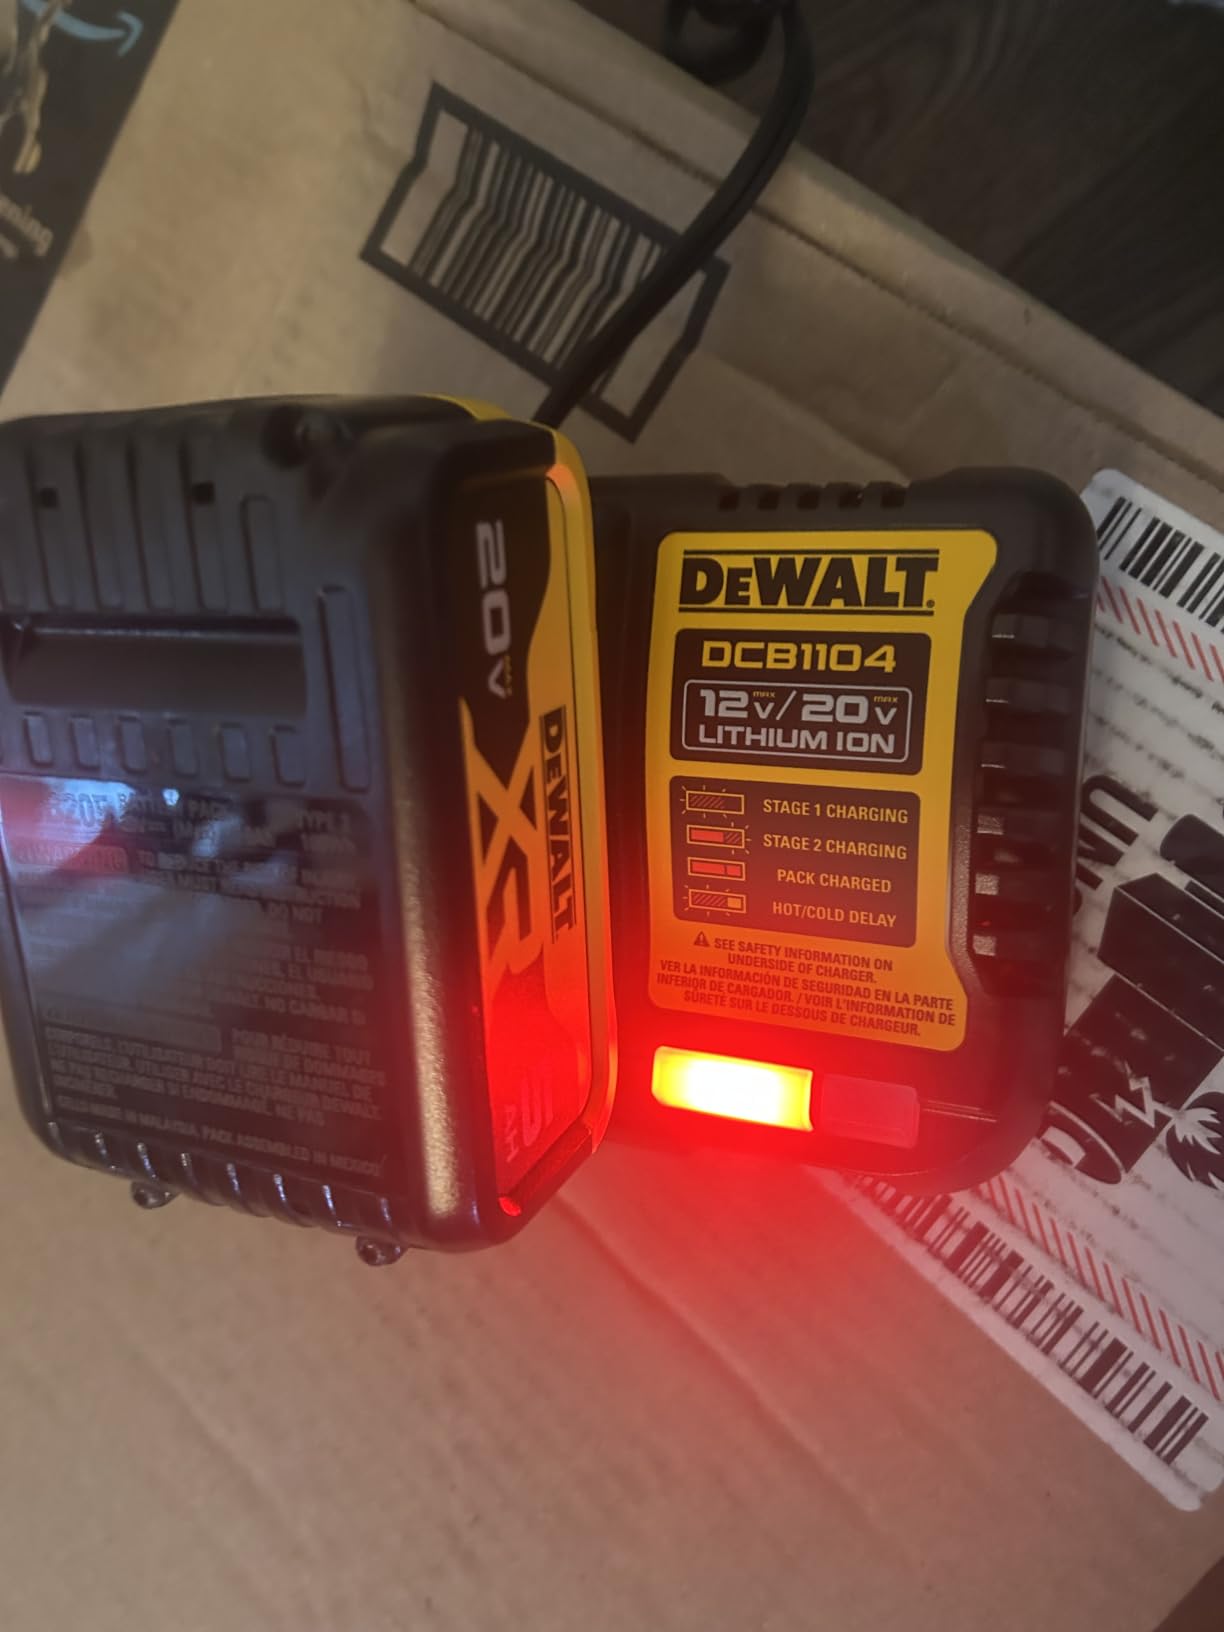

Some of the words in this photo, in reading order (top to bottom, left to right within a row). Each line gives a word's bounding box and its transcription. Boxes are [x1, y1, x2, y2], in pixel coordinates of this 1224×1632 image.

[680, 556, 939, 608] DEWALT
[701, 640, 896, 673] DCB1104
[699, 725, 827, 750] LITHIUM
[836, 731, 895, 754] ION
[763, 799, 812, 817] STAGE
[815, 803, 822, 817] 1
[827, 805, 908, 824] CHARGING
[763, 834, 812, 851] STAGE
[814, 838, 822, 852] 2
[826, 839, 907, 860] CHARGING
[777, 869, 815, 886] PACK
[820, 874, 891, 893] CHARGED
[773, 901, 845, 922] HOT/COLD
[849, 908, 896, 928] DELAY
[714, 938, 735, 951] SEE
[738, 940, 782, 957] SAFETY
[785, 947, 871, 969] INFORMATION
[874, 959, 893, 972] ON
[728, 953, 795, 972] UNDERSIDE
[798, 963, 814, 975] OF
[660, 959, 681, 973] VER
[683, 962, 697, 975] LA
[784, 976, 799, 990] DE
[802, 979, 871, 999] SEGURIDAD
[874, 989, 891, 1002] EN
[895, 991, 910, 1005] LA
[914, 993, 953, 1010] PARTE
[709, 979, 724, 993] DE
[938, 1012, 956, 1026] DE
[729, 996, 753, 1012] SUR
[756, 1001, 768, 1014] LE
[771, 1003, 828, 1021] DESSOUS
[831, 1010, 847, 1025] DE
